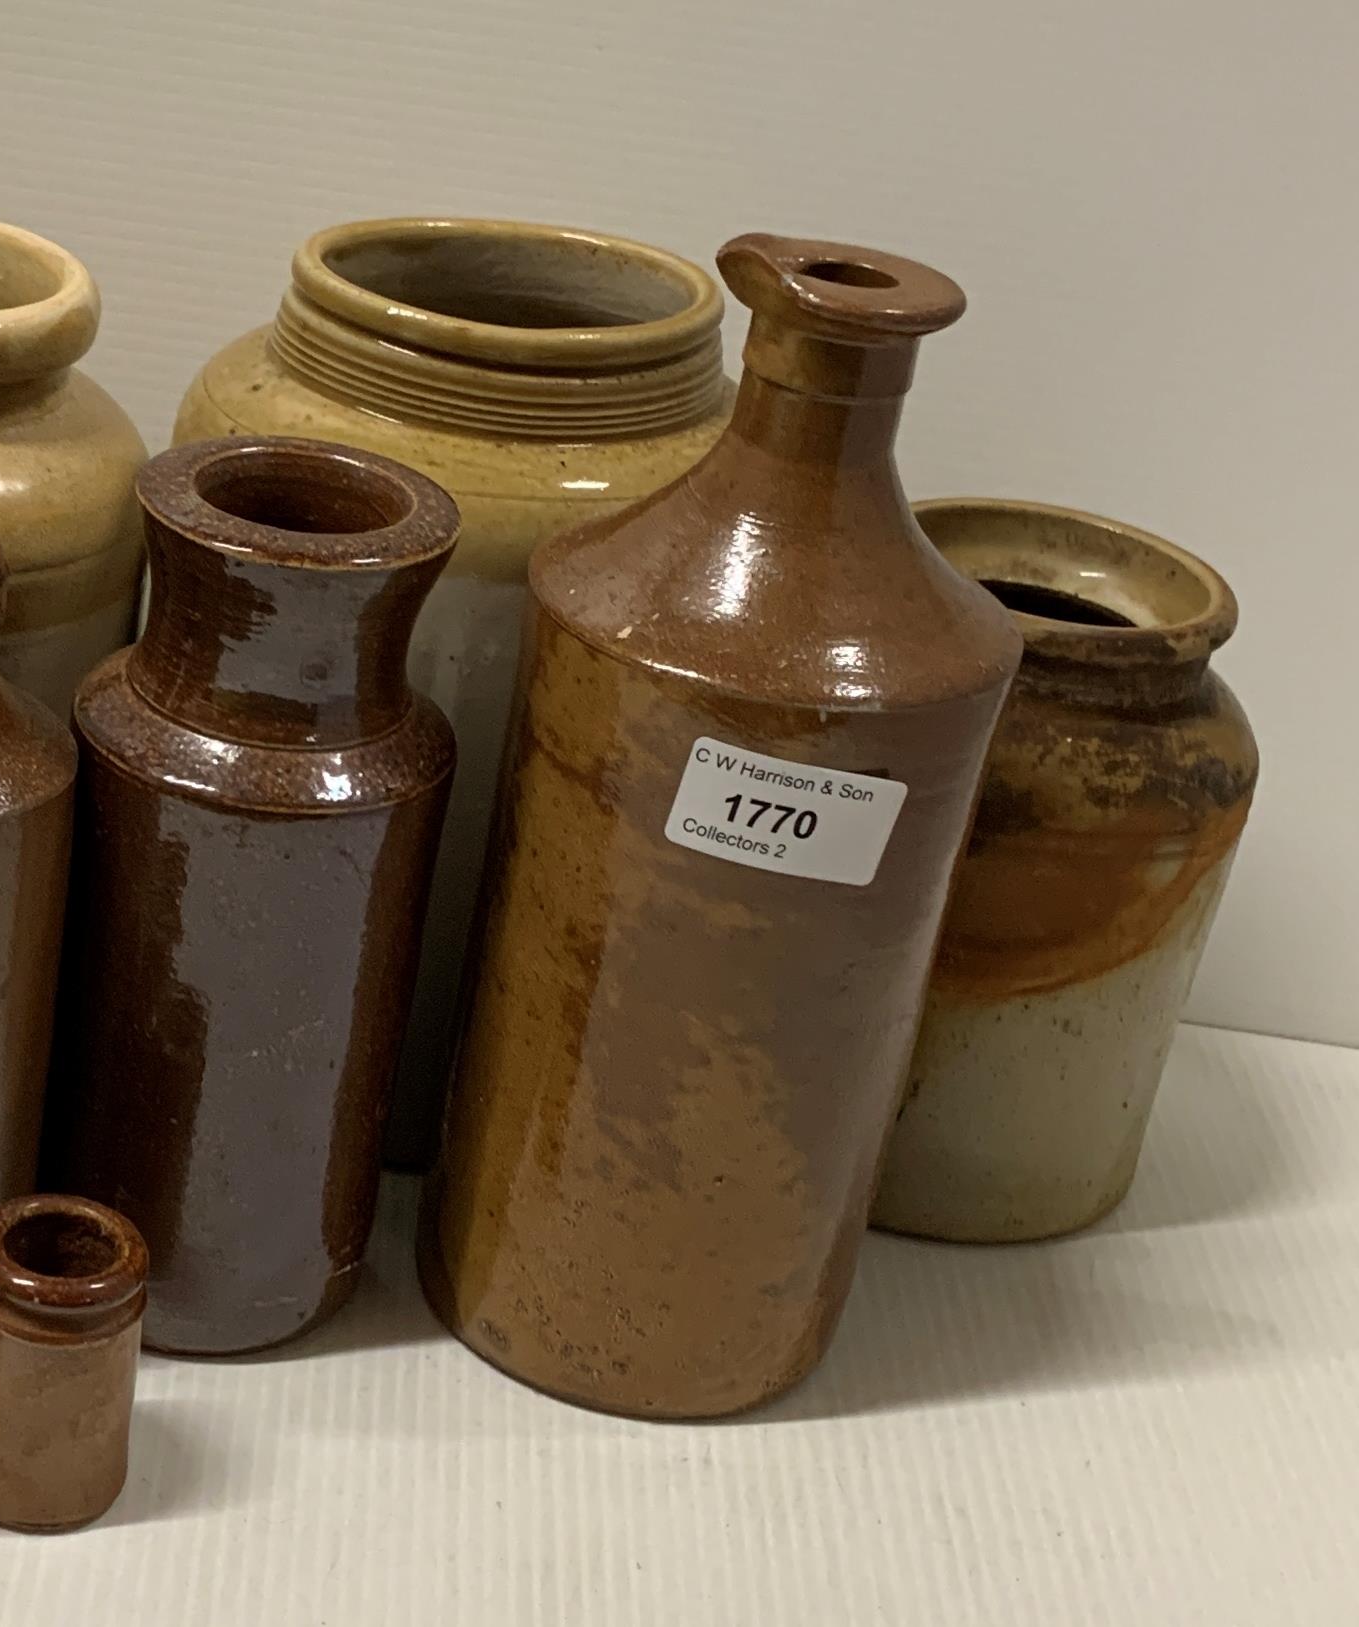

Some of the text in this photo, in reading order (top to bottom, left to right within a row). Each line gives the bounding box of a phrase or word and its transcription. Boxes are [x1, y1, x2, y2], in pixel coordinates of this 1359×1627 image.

[695, 747, 874, 803] C W Harrison & Son
[682, 817, 787, 859] Collectors 2
[724, 794, 818, 840] 1770
